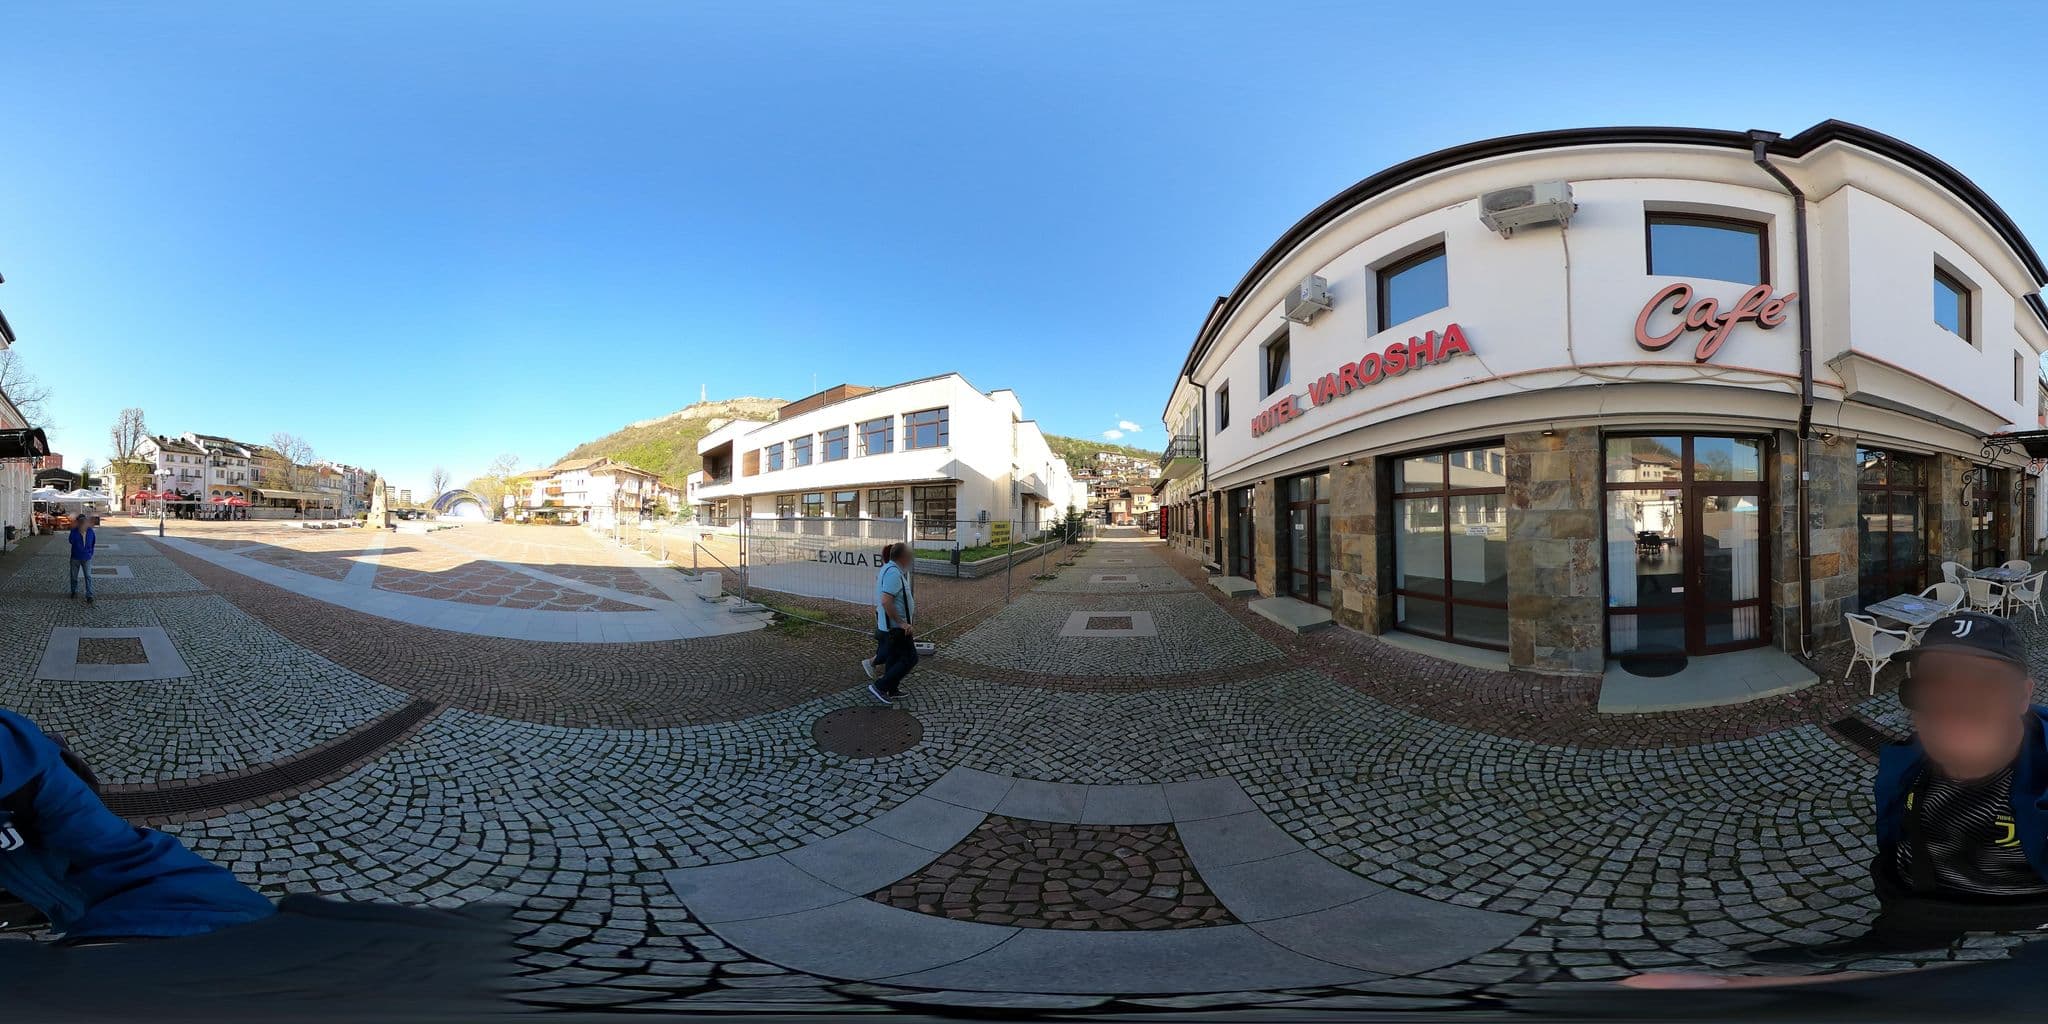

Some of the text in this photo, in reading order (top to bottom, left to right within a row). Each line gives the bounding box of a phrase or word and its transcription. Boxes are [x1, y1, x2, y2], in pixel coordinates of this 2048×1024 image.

[1634, 282, 1798, 362] Café
[1251, 323, 1475, 438] HOTEL VAROSHA
[787, 546, 869, 567] НАДЕЖДА
